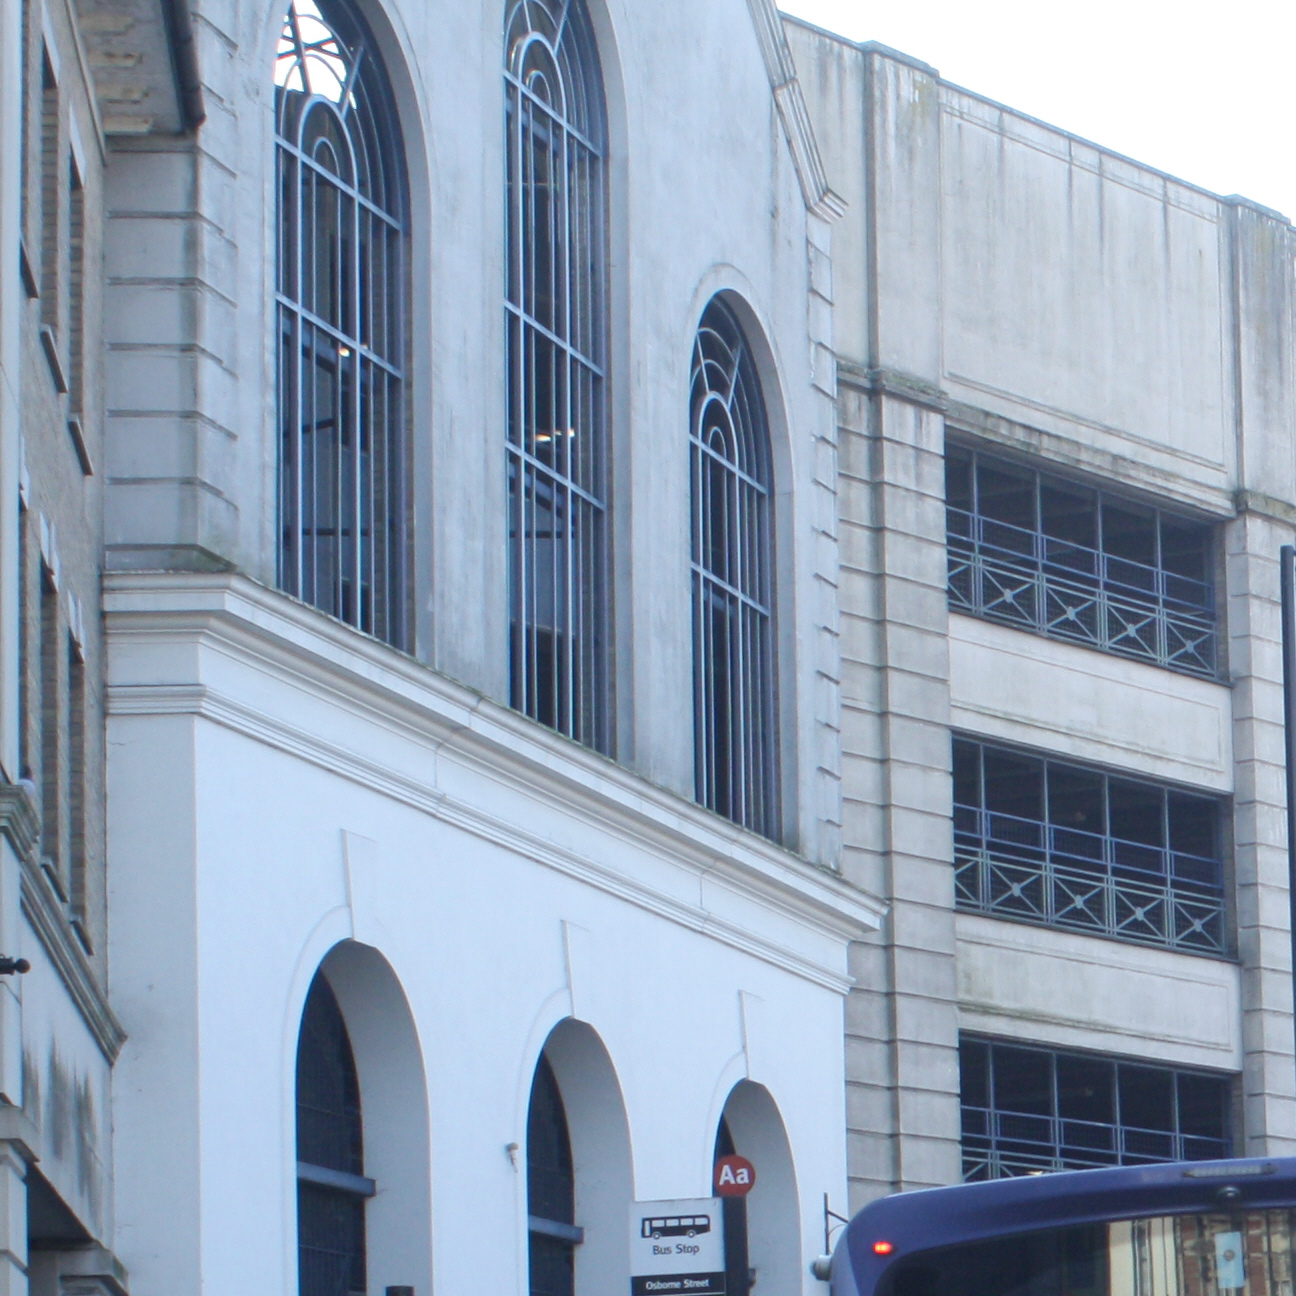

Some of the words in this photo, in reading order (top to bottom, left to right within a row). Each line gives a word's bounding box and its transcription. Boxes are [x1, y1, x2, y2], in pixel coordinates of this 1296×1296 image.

[719, 1165, 750, 1186] Aa
[652, 1245, 672, 1255] Bus
[675, 1243, 700, 1255] Stop
[645, 1281, 681, 1290] Osborne
[683, 1279, 710, 1289] Street
